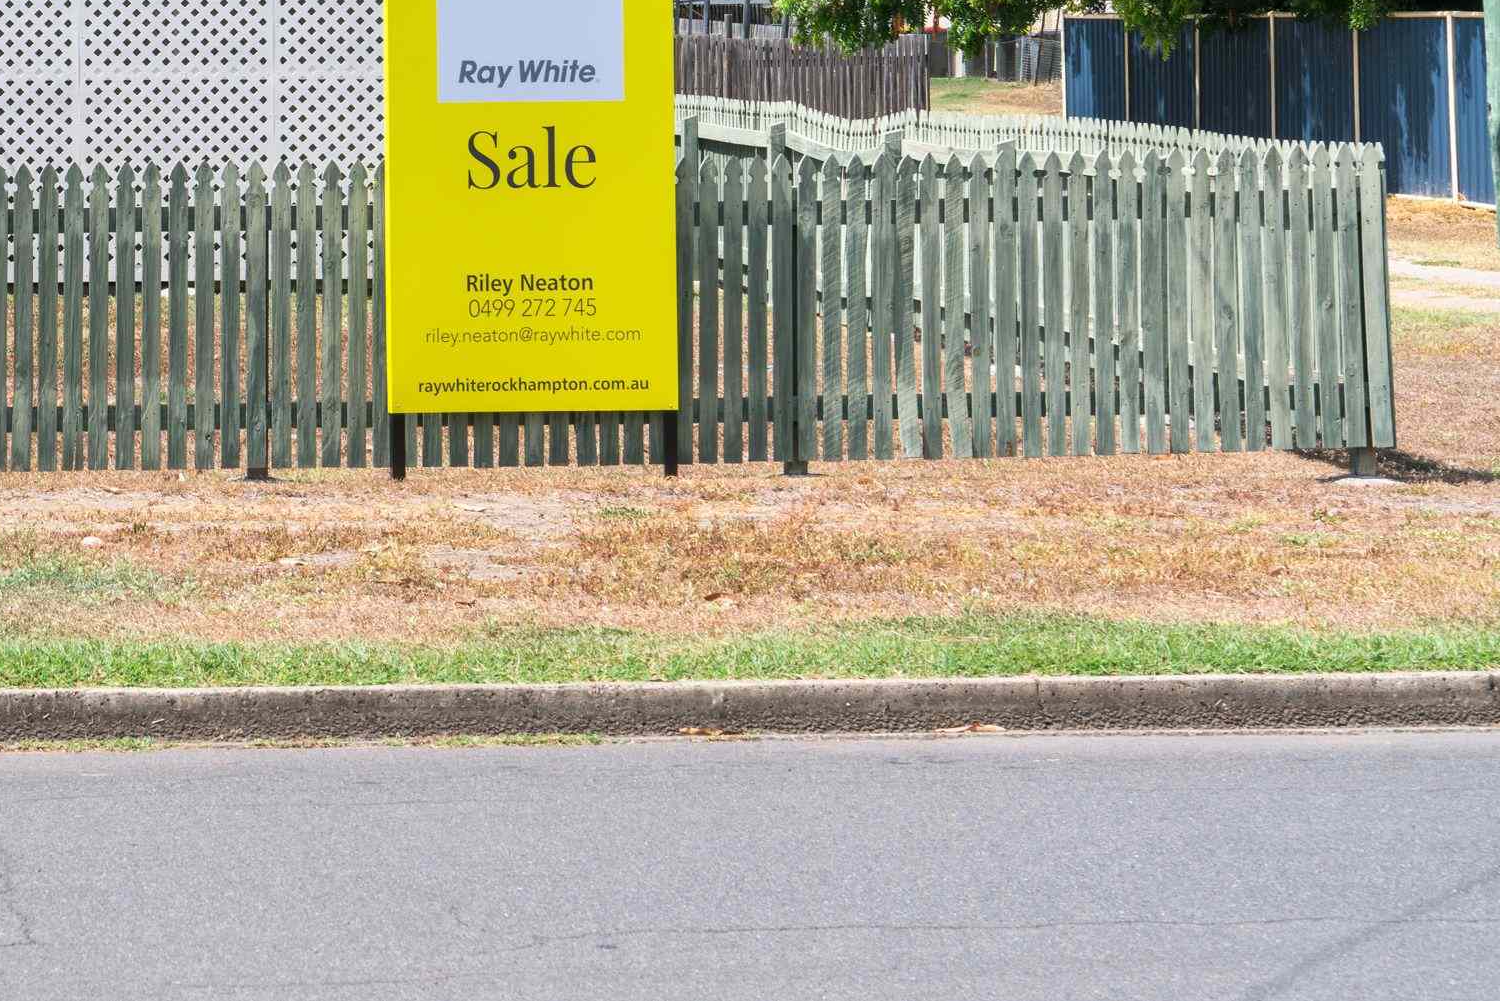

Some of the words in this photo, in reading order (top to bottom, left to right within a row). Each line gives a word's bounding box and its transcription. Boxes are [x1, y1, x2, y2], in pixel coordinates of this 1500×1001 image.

[458, 60, 513, 88] Ray
[518, 60, 596, 84] White
[467, 126, 597, 190] Sale
[466, 274, 513, 296] Riley
[520, 273, 594, 292] Neaton
[468, 298, 516, 318] 0499
[521, 298, 556, 317] 272
[562, 297, 597, 317] 745
[425, 326, 641, 347] riley.neaton@raywhite.com
[418, 377, 649, 396] raywhiterockhampton.com.au
